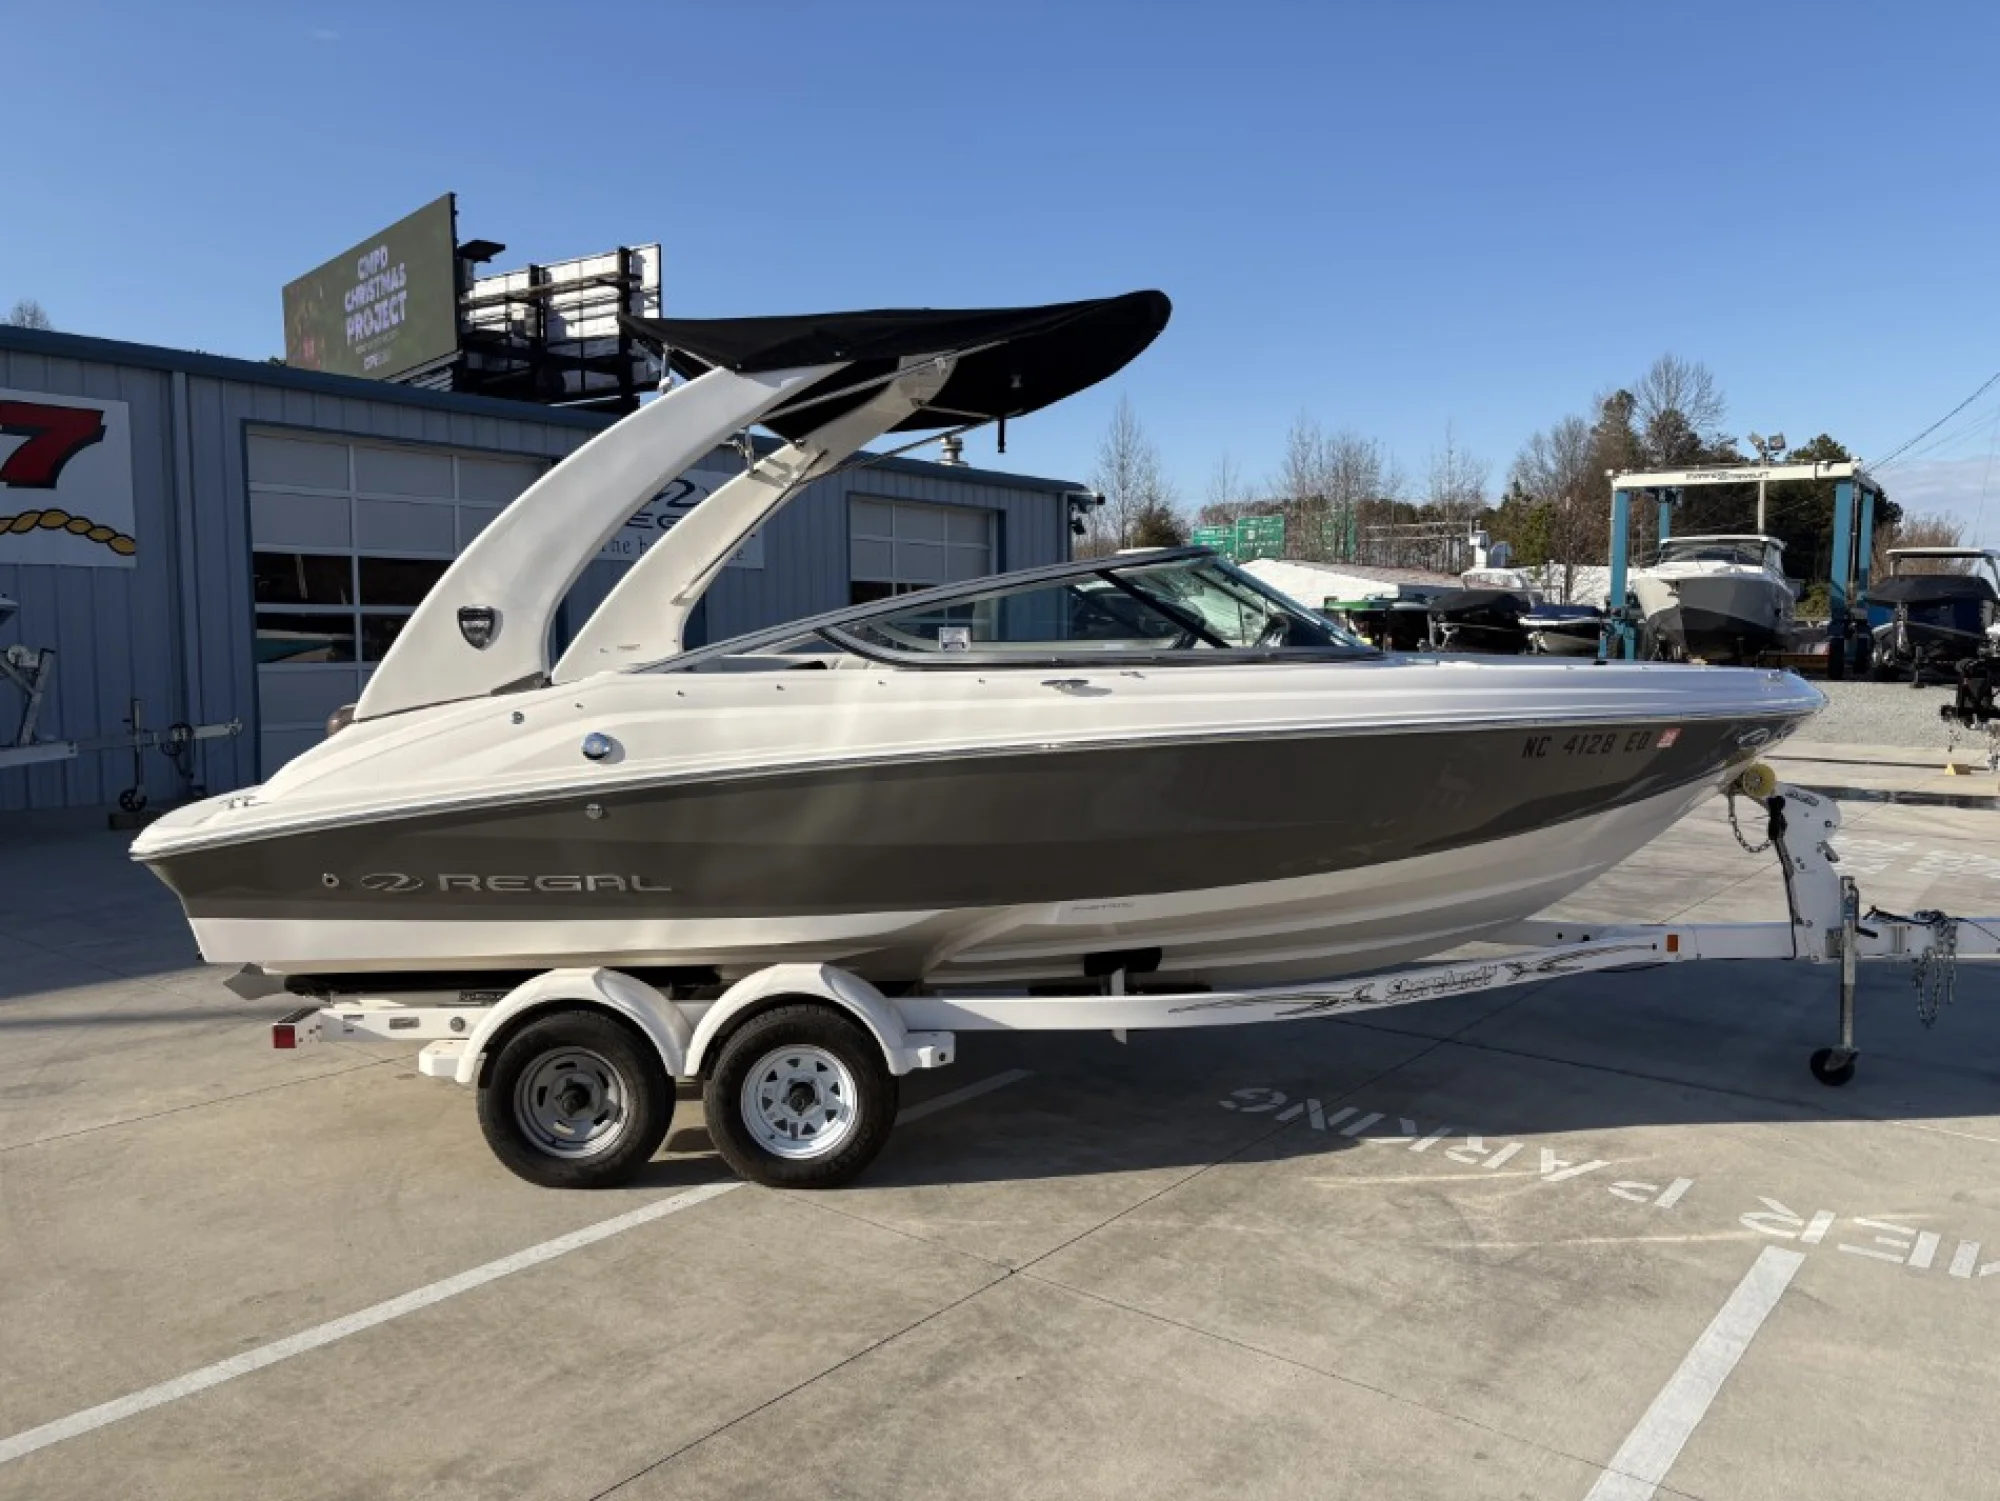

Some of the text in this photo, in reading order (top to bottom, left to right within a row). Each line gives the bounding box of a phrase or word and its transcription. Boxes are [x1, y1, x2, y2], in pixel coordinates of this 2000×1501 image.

[344, 262, 407, 313] CHRISTMAS
[346, 289, 407, 347] PROJECT
[1521, 734, 1553, 759] NC
[1562, 732, 1618, 756] 4128
[438, 873, 672, 892] REGAL
[1217, 1086, 1695, 1209] PARKING
